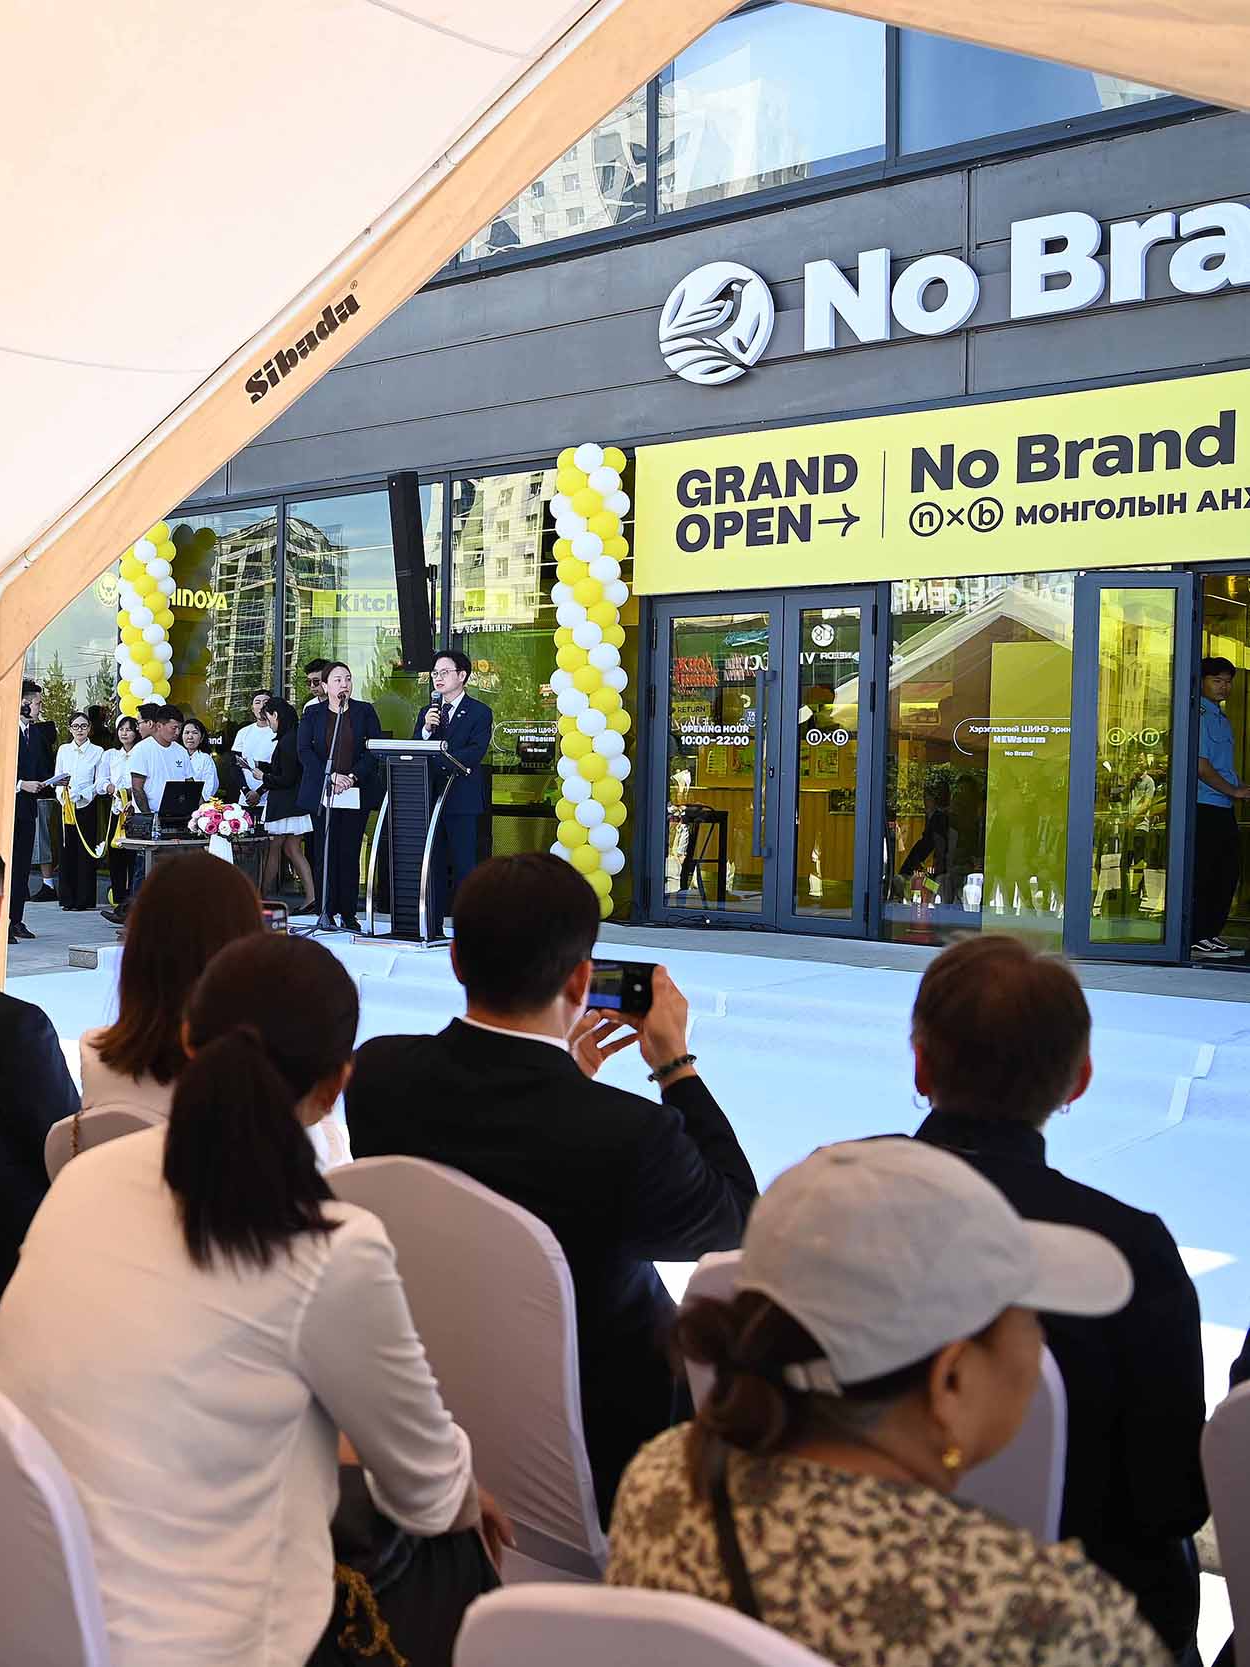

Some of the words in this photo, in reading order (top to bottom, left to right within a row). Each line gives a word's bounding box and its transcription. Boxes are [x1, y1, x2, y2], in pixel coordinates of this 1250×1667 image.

[803, 248, 980, 352] No
[245, 293, 361, 405] Sibada
[911, 443, 1000, 494] No
[1016, 410, 1237, 485] Brand
[676, 454, 859, 509] GRAND
[675, 503, 812, 553] OPEN
[1016, 491, 1188, 528] МОНГОЛЫН
[680, 724, 722, 734] OPENING
[722, 724, 750, 734] HOUR
[1021, 724, 1050, 734] ШИНЭ
